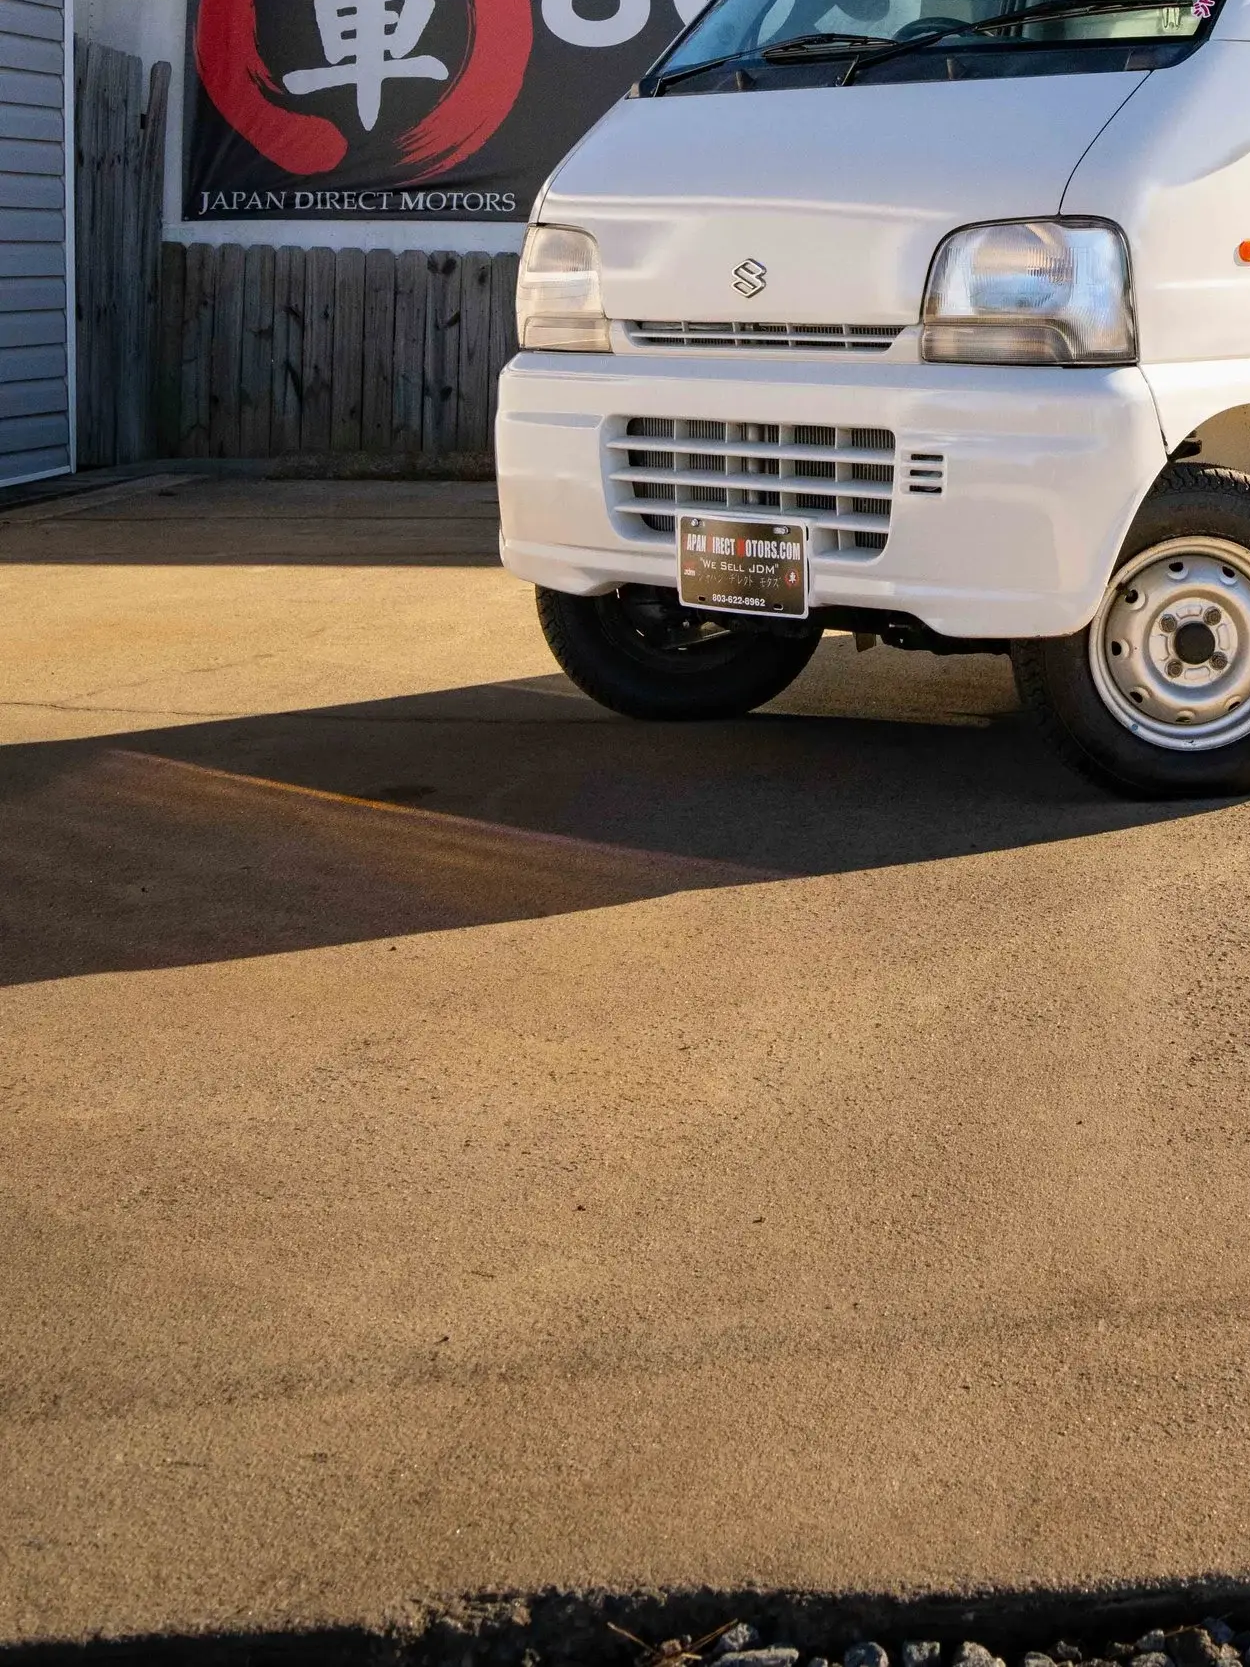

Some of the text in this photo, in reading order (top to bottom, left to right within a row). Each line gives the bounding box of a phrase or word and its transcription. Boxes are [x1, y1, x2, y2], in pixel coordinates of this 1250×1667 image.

[199, 191, 517, 215] JAPAN DIRECT MOTORS
